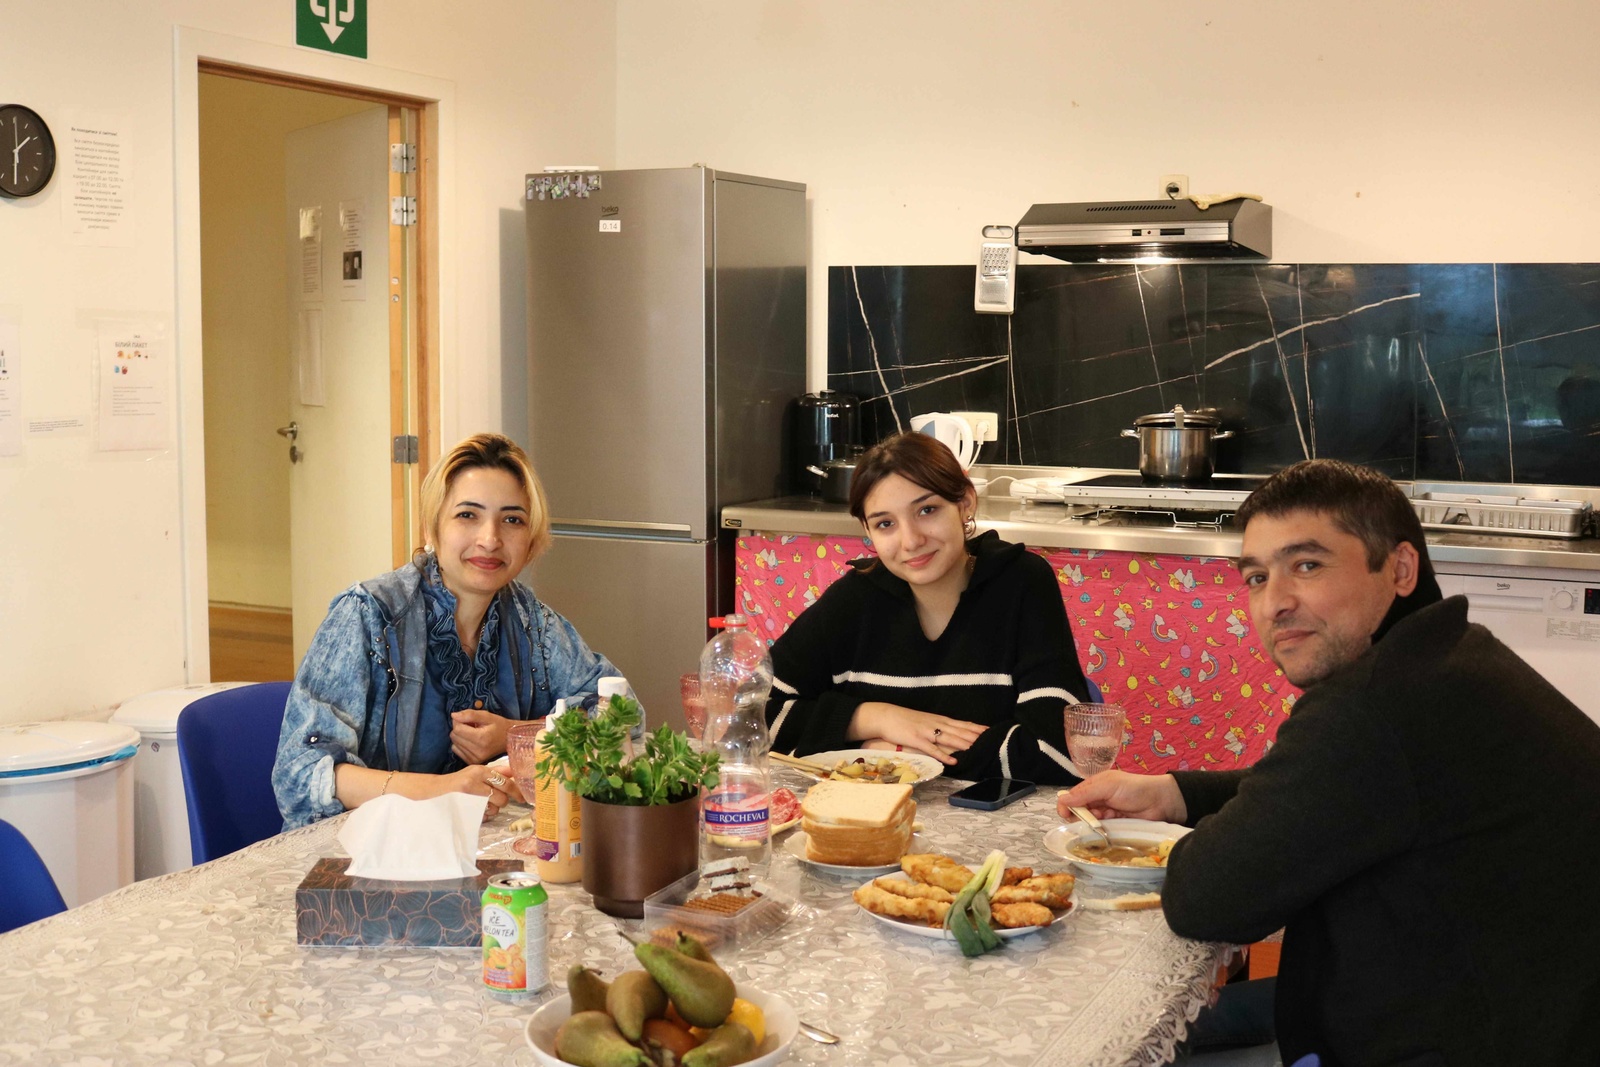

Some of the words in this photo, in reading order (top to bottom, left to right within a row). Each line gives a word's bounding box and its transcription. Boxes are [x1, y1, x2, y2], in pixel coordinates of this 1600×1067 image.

[601, 204, 619, 214] beko
[602, 222, 618, 230] 0.14
[719, 811, 766, 823] ROCHEVAL
[489, 916, 501, 924] ICE
[502, 928, 515, 937] TEA
